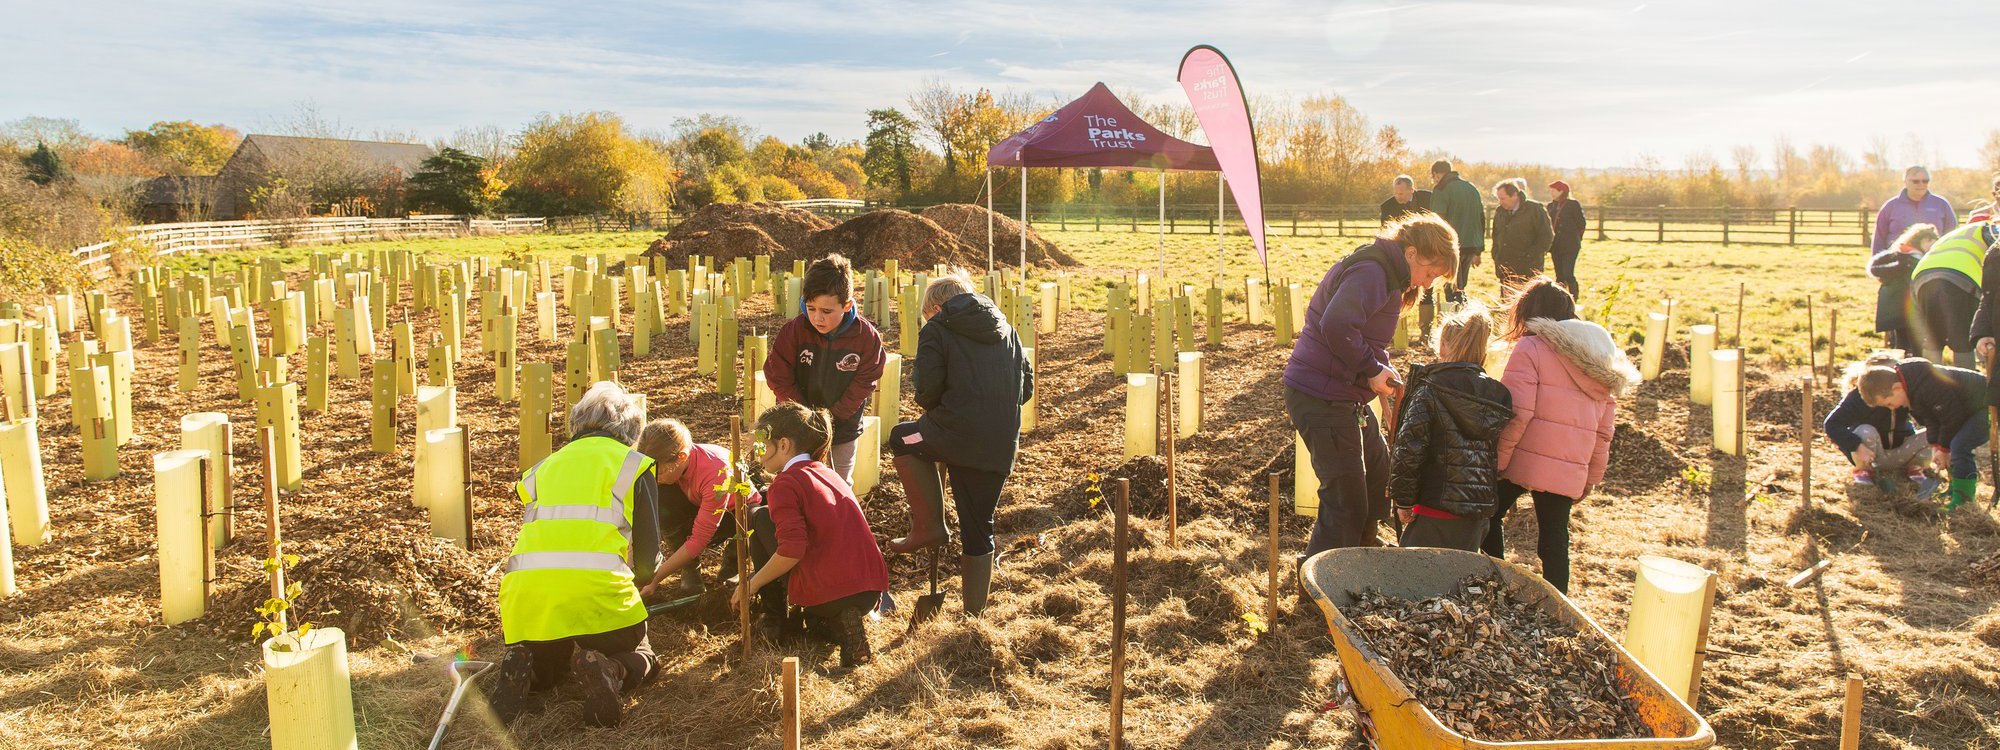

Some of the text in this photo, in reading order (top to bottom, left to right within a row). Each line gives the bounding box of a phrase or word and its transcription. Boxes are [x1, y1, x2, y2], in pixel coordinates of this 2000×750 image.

[1083, 114, 1117, 127] The
[1088, 127, 1146, 141] Parks
[1088, 138, 1135, 149] Trust
